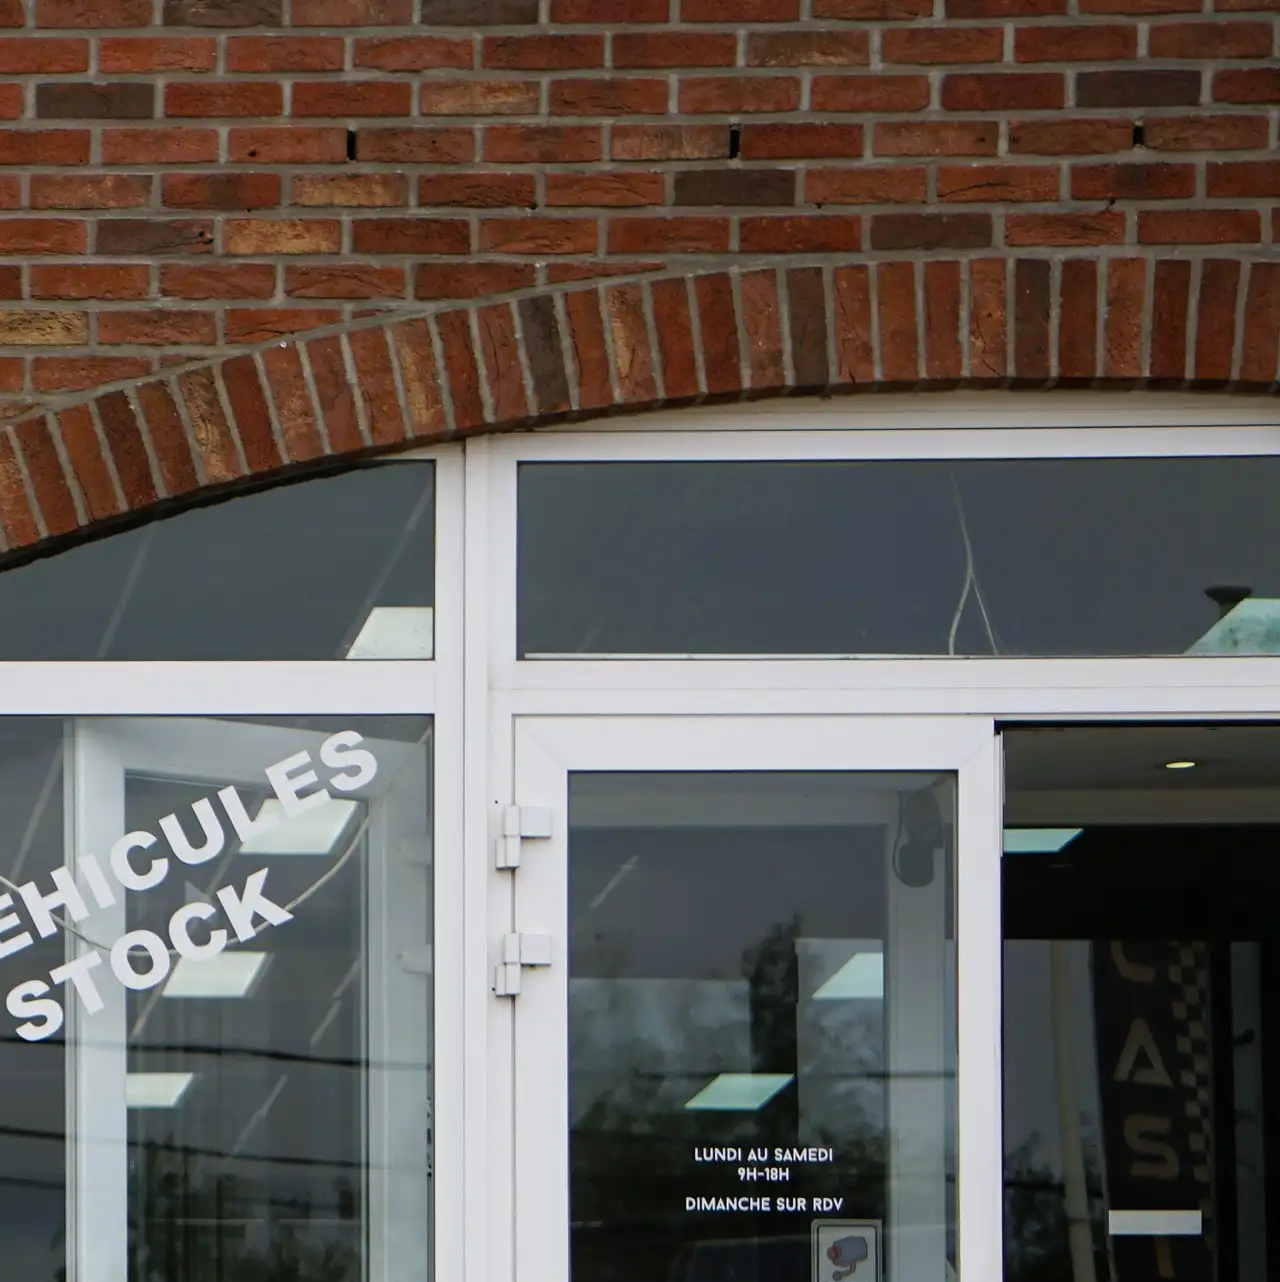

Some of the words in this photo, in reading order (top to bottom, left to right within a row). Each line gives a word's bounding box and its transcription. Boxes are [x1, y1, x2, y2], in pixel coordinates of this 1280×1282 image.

[5, 867, 295, 1042] STOCK
[694, 1147, 742, 1162] LUNDI
[747, 1147, 768, 1162] AU
[774, 1147, 833, 1162] SAMEDI
[737, 1167, 789, 1182] 9H-18H
[685, 1196, 771, 1212] DIMANCHE
[776, 1196, 807, 1212] SUR
[813, 1196, 843, 1212] RDV
